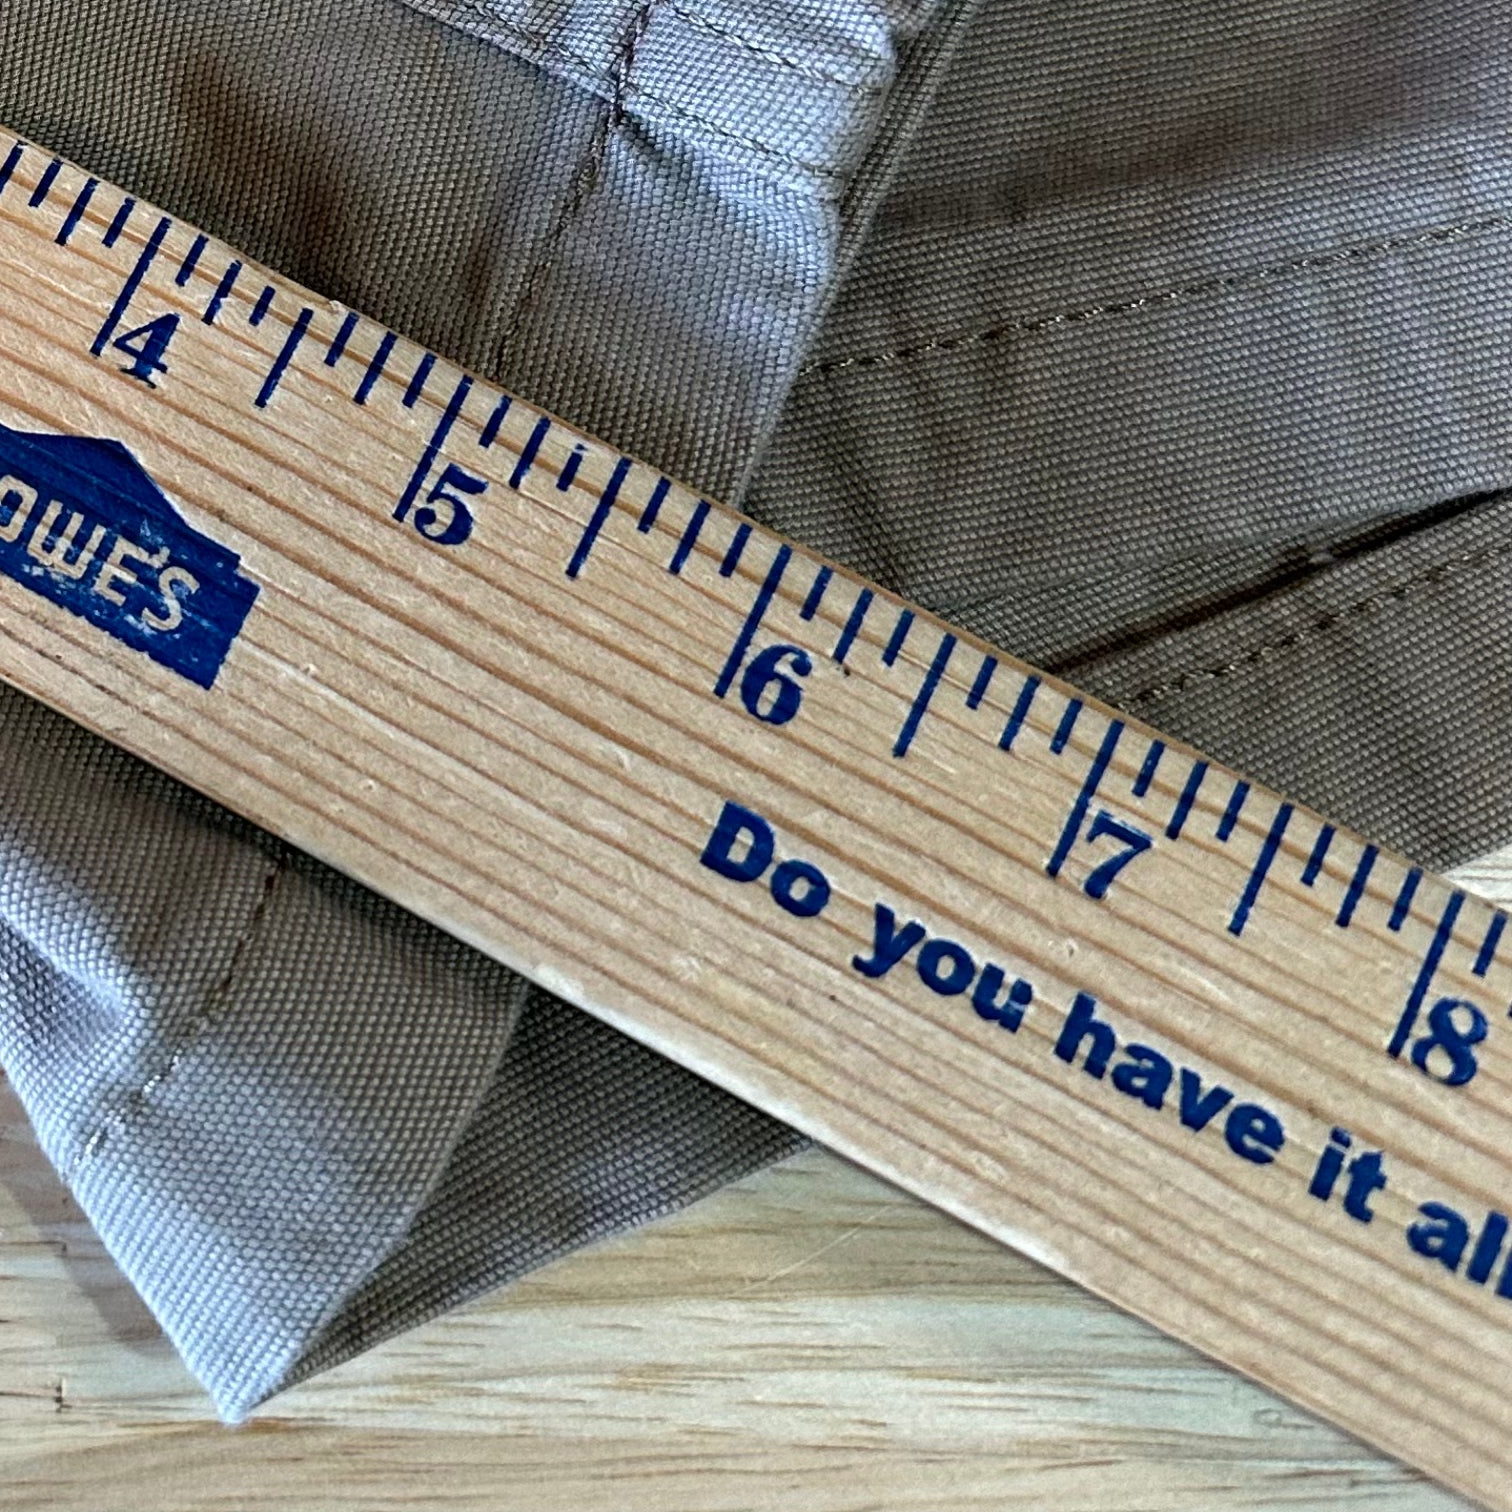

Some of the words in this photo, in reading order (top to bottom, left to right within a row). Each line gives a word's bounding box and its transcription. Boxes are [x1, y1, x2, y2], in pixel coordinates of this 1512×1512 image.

[112, 311, 182, 388] 4
[412, 461, 489, 547] 5
[738, 643, 814, 726] 6
[1081, 808, 1154, 900] 7
[1409, 996, 1489, 1088] 8
[699, 799, 833, 918] Do
[851, 902, 1035, 1034] you
[1053, 991, 1287, 1167] have
[1307, 1126, 1389, 1225] it
